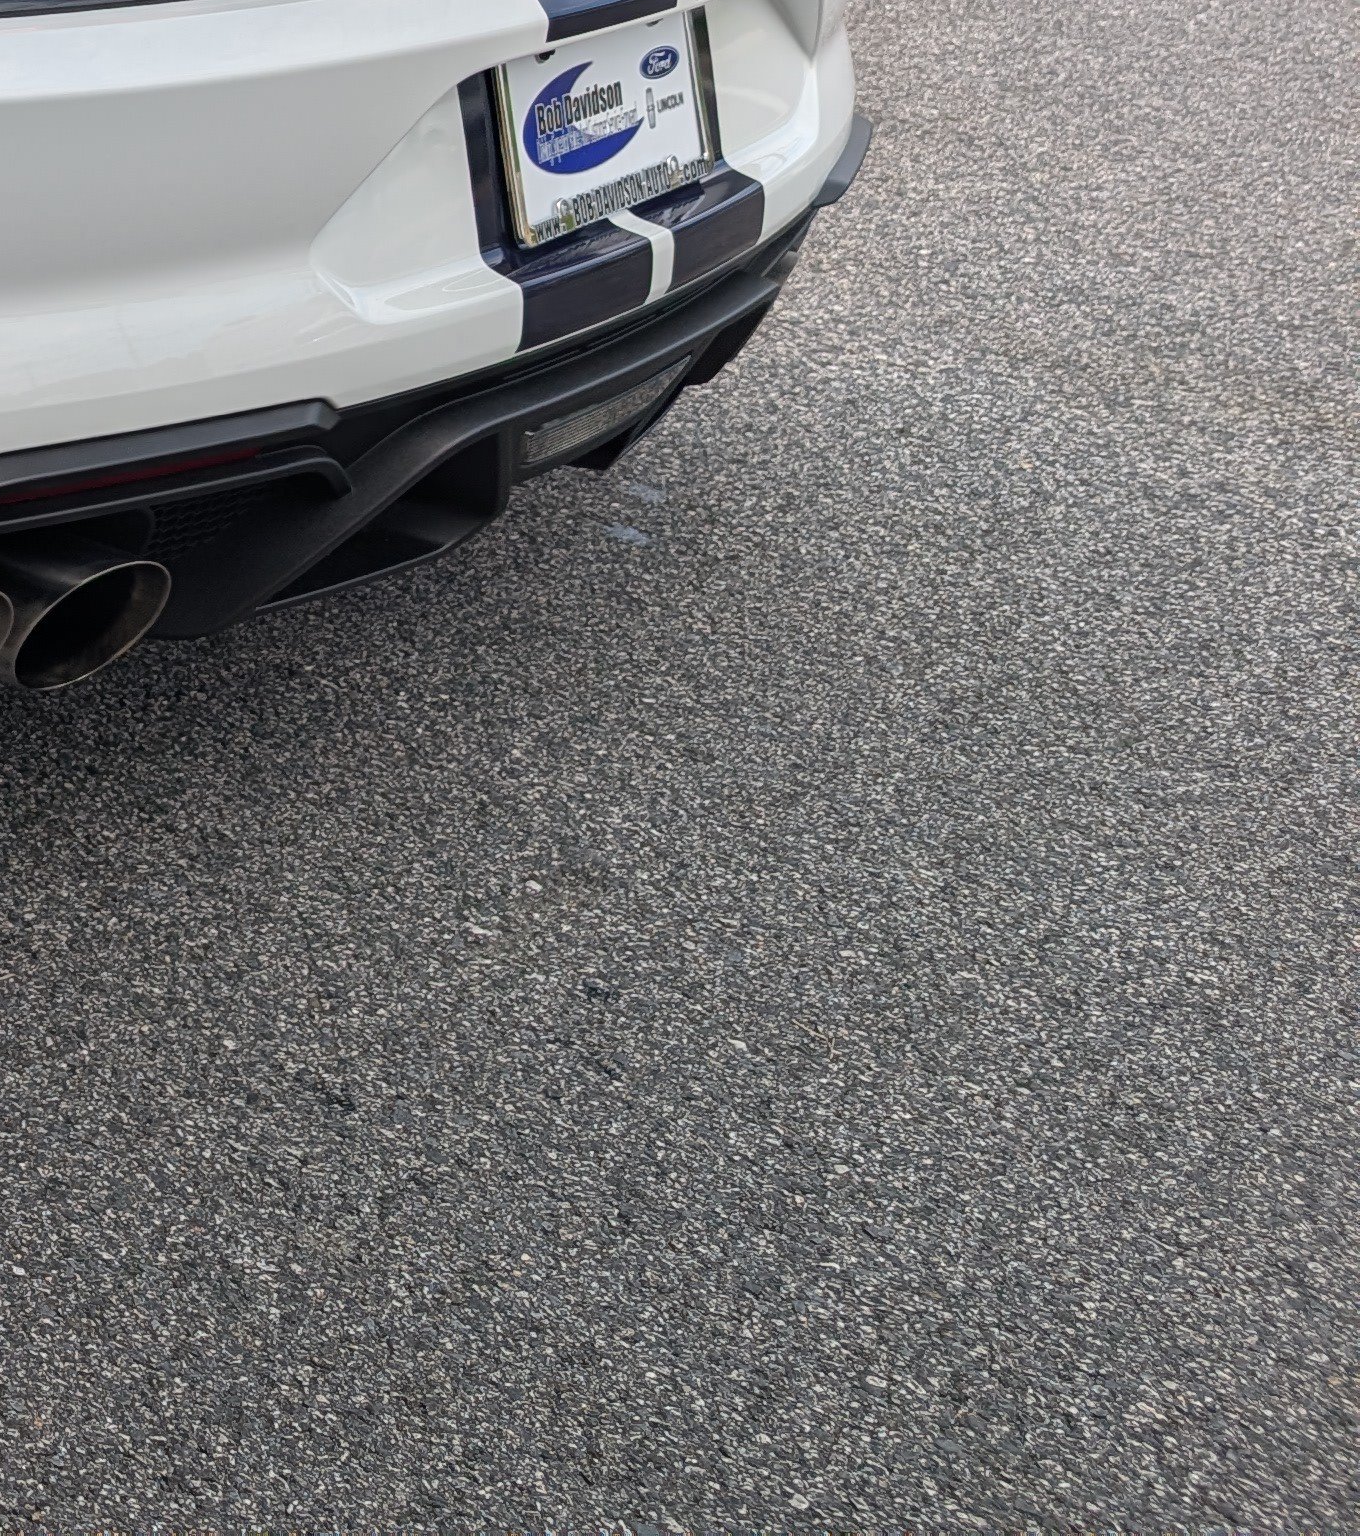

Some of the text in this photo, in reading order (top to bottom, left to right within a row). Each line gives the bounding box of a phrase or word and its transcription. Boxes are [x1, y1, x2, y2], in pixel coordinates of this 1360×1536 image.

[646, 51, 673, 75] Ford
[536, 97, 563, 136] Bob
[564, 80, 624, 126] Davidson
[656, 91, 685, 113] LINCOLN
